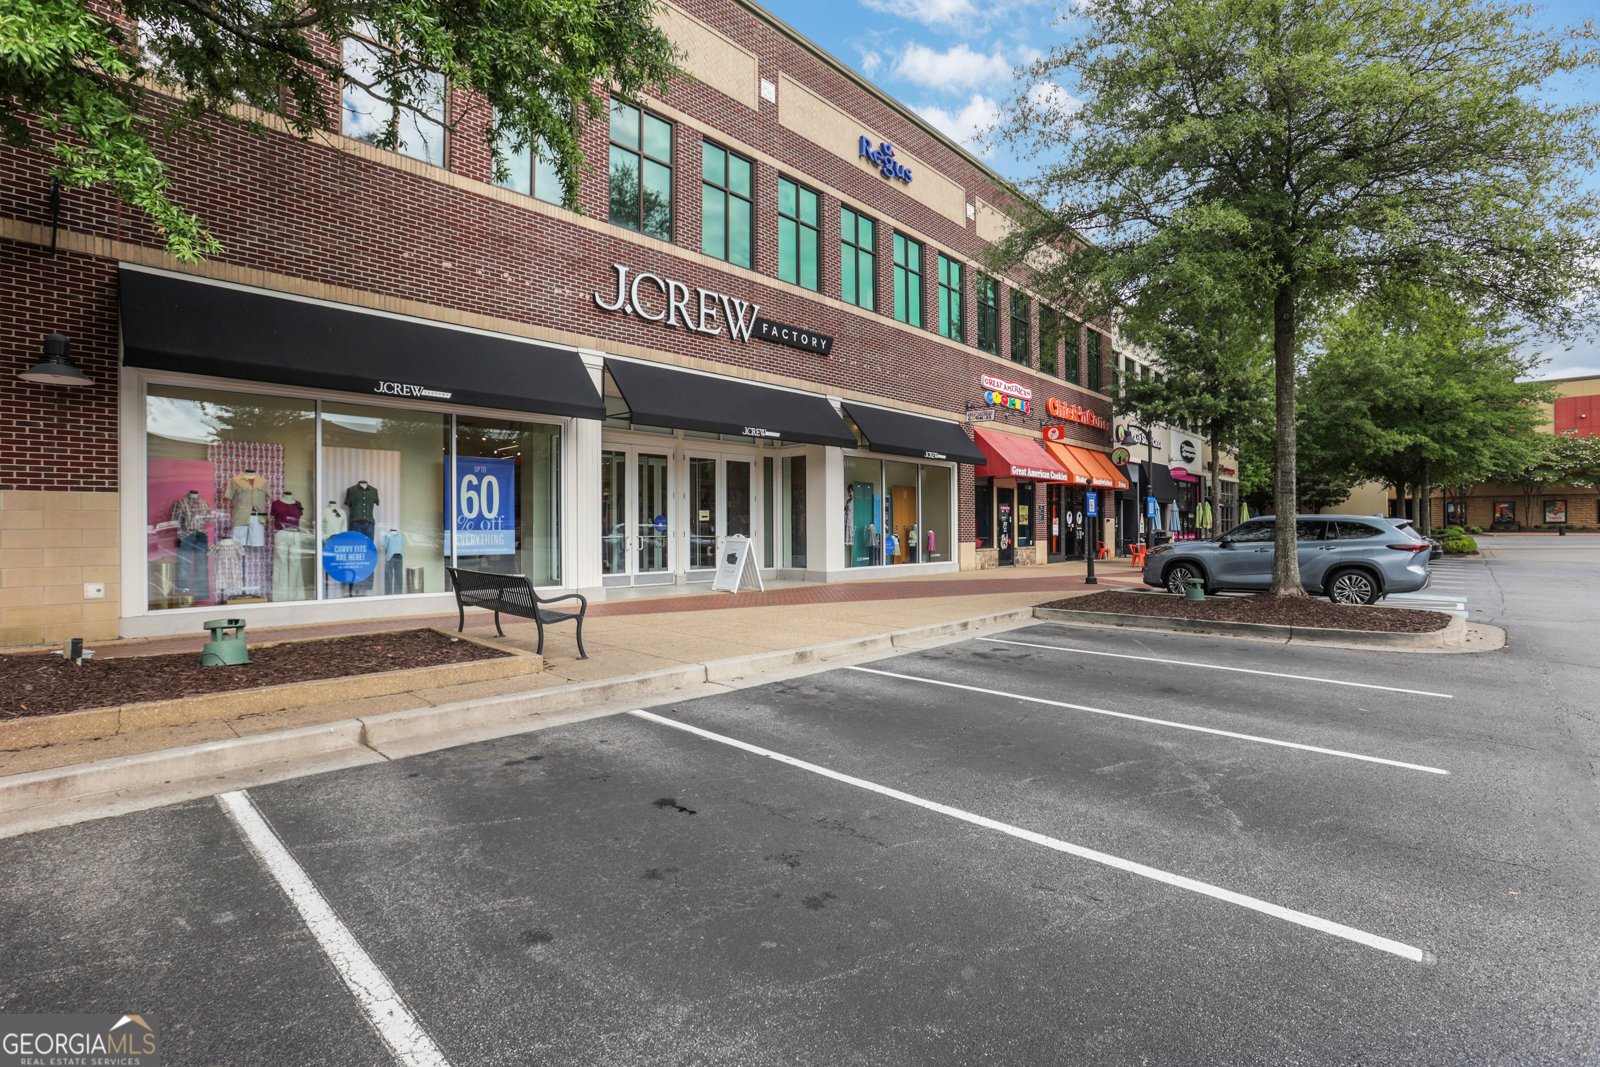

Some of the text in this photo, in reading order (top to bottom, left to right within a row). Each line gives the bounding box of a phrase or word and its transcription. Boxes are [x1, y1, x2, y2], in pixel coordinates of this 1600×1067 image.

[858, 135, 913, 184] Regus
[594, 263, 827, 350] J.CREW FACTORY
[373, 381, 425, 397] J.CREW
[984, 377, 1031, 398] GREAT AMERICAN
[984, 390, 1030, 414] COOKIES
[473, 465, 487, 474] UP TO
[1011, 465, 1027, 476] Great
[1027, 467, 1050, 479] American
[460, 474, 500, 519] 60
[480, 514, 505, 531] off
[456, 533, 505, 546] EVERYTHING
[334, 545, 367, 553] CURVY FITS
[335, 553, 347, 561] ARE
